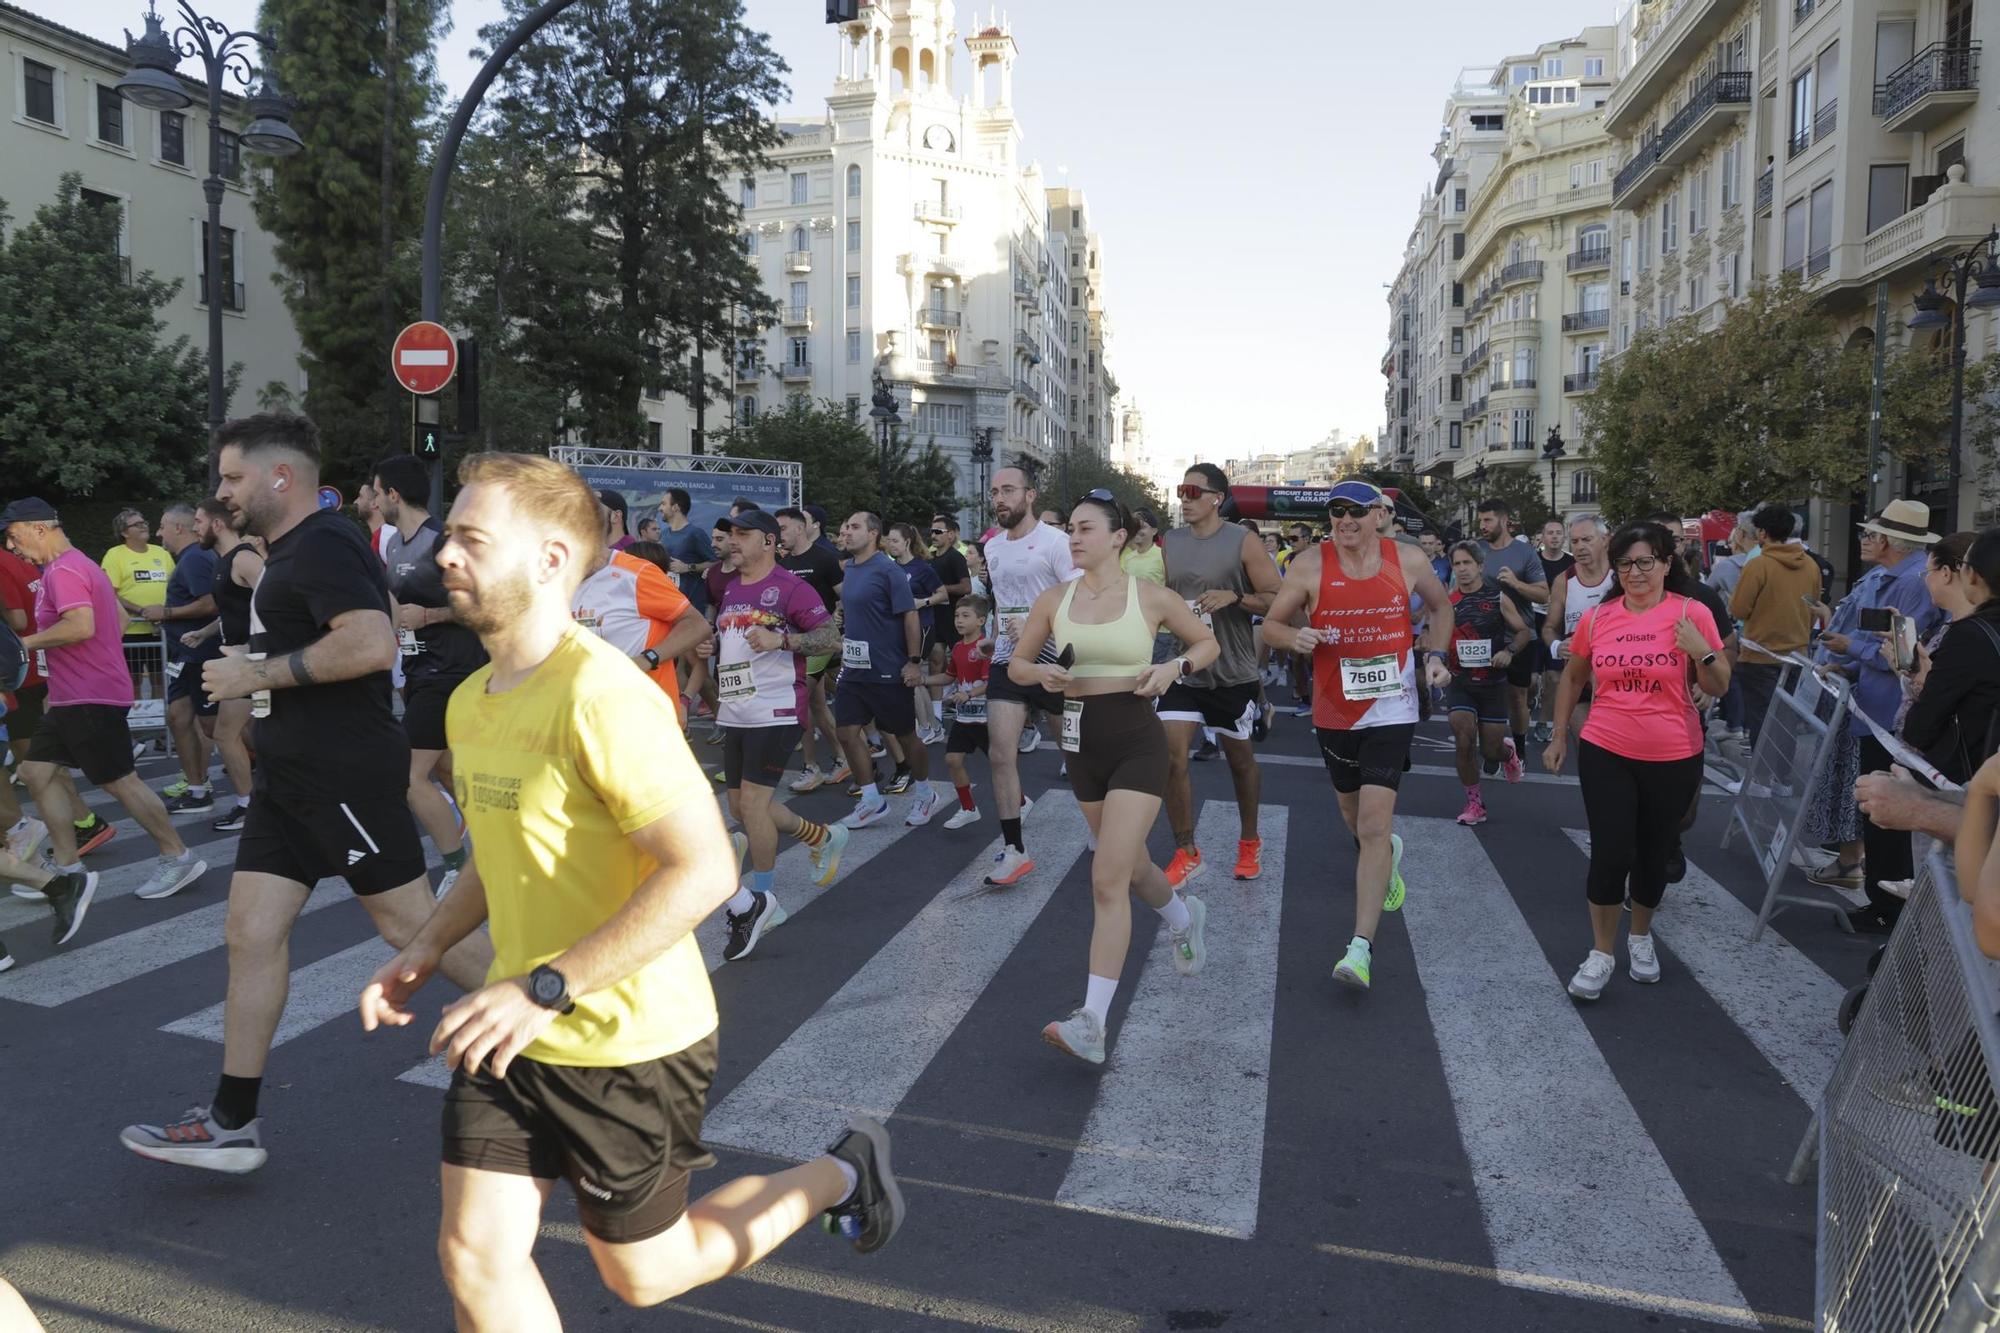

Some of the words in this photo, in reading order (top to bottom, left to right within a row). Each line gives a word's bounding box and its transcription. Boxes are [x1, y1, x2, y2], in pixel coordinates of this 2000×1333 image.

[587, 477, 626, 486] EXPOSICIÓN
[653, 480, 688, 489] FUNDACIÓN
[688, 482, 715, 490] BANCAJA
[1358, 626, 1382, 634] CASA
[1376, 631, 1405, 642] AROMAS
[1625, 633, 1657, 642] Disate
[846, 645, 861, 656] 318
[1460, 645, 1487, 655] 1323
[1595, 652, 1678, 668] COLOSOS
[1349, 670, 1387, 684] 7560
[1623, 668, 1647, 678] DEL
[1610, 680, 1662, 693] TURIA
